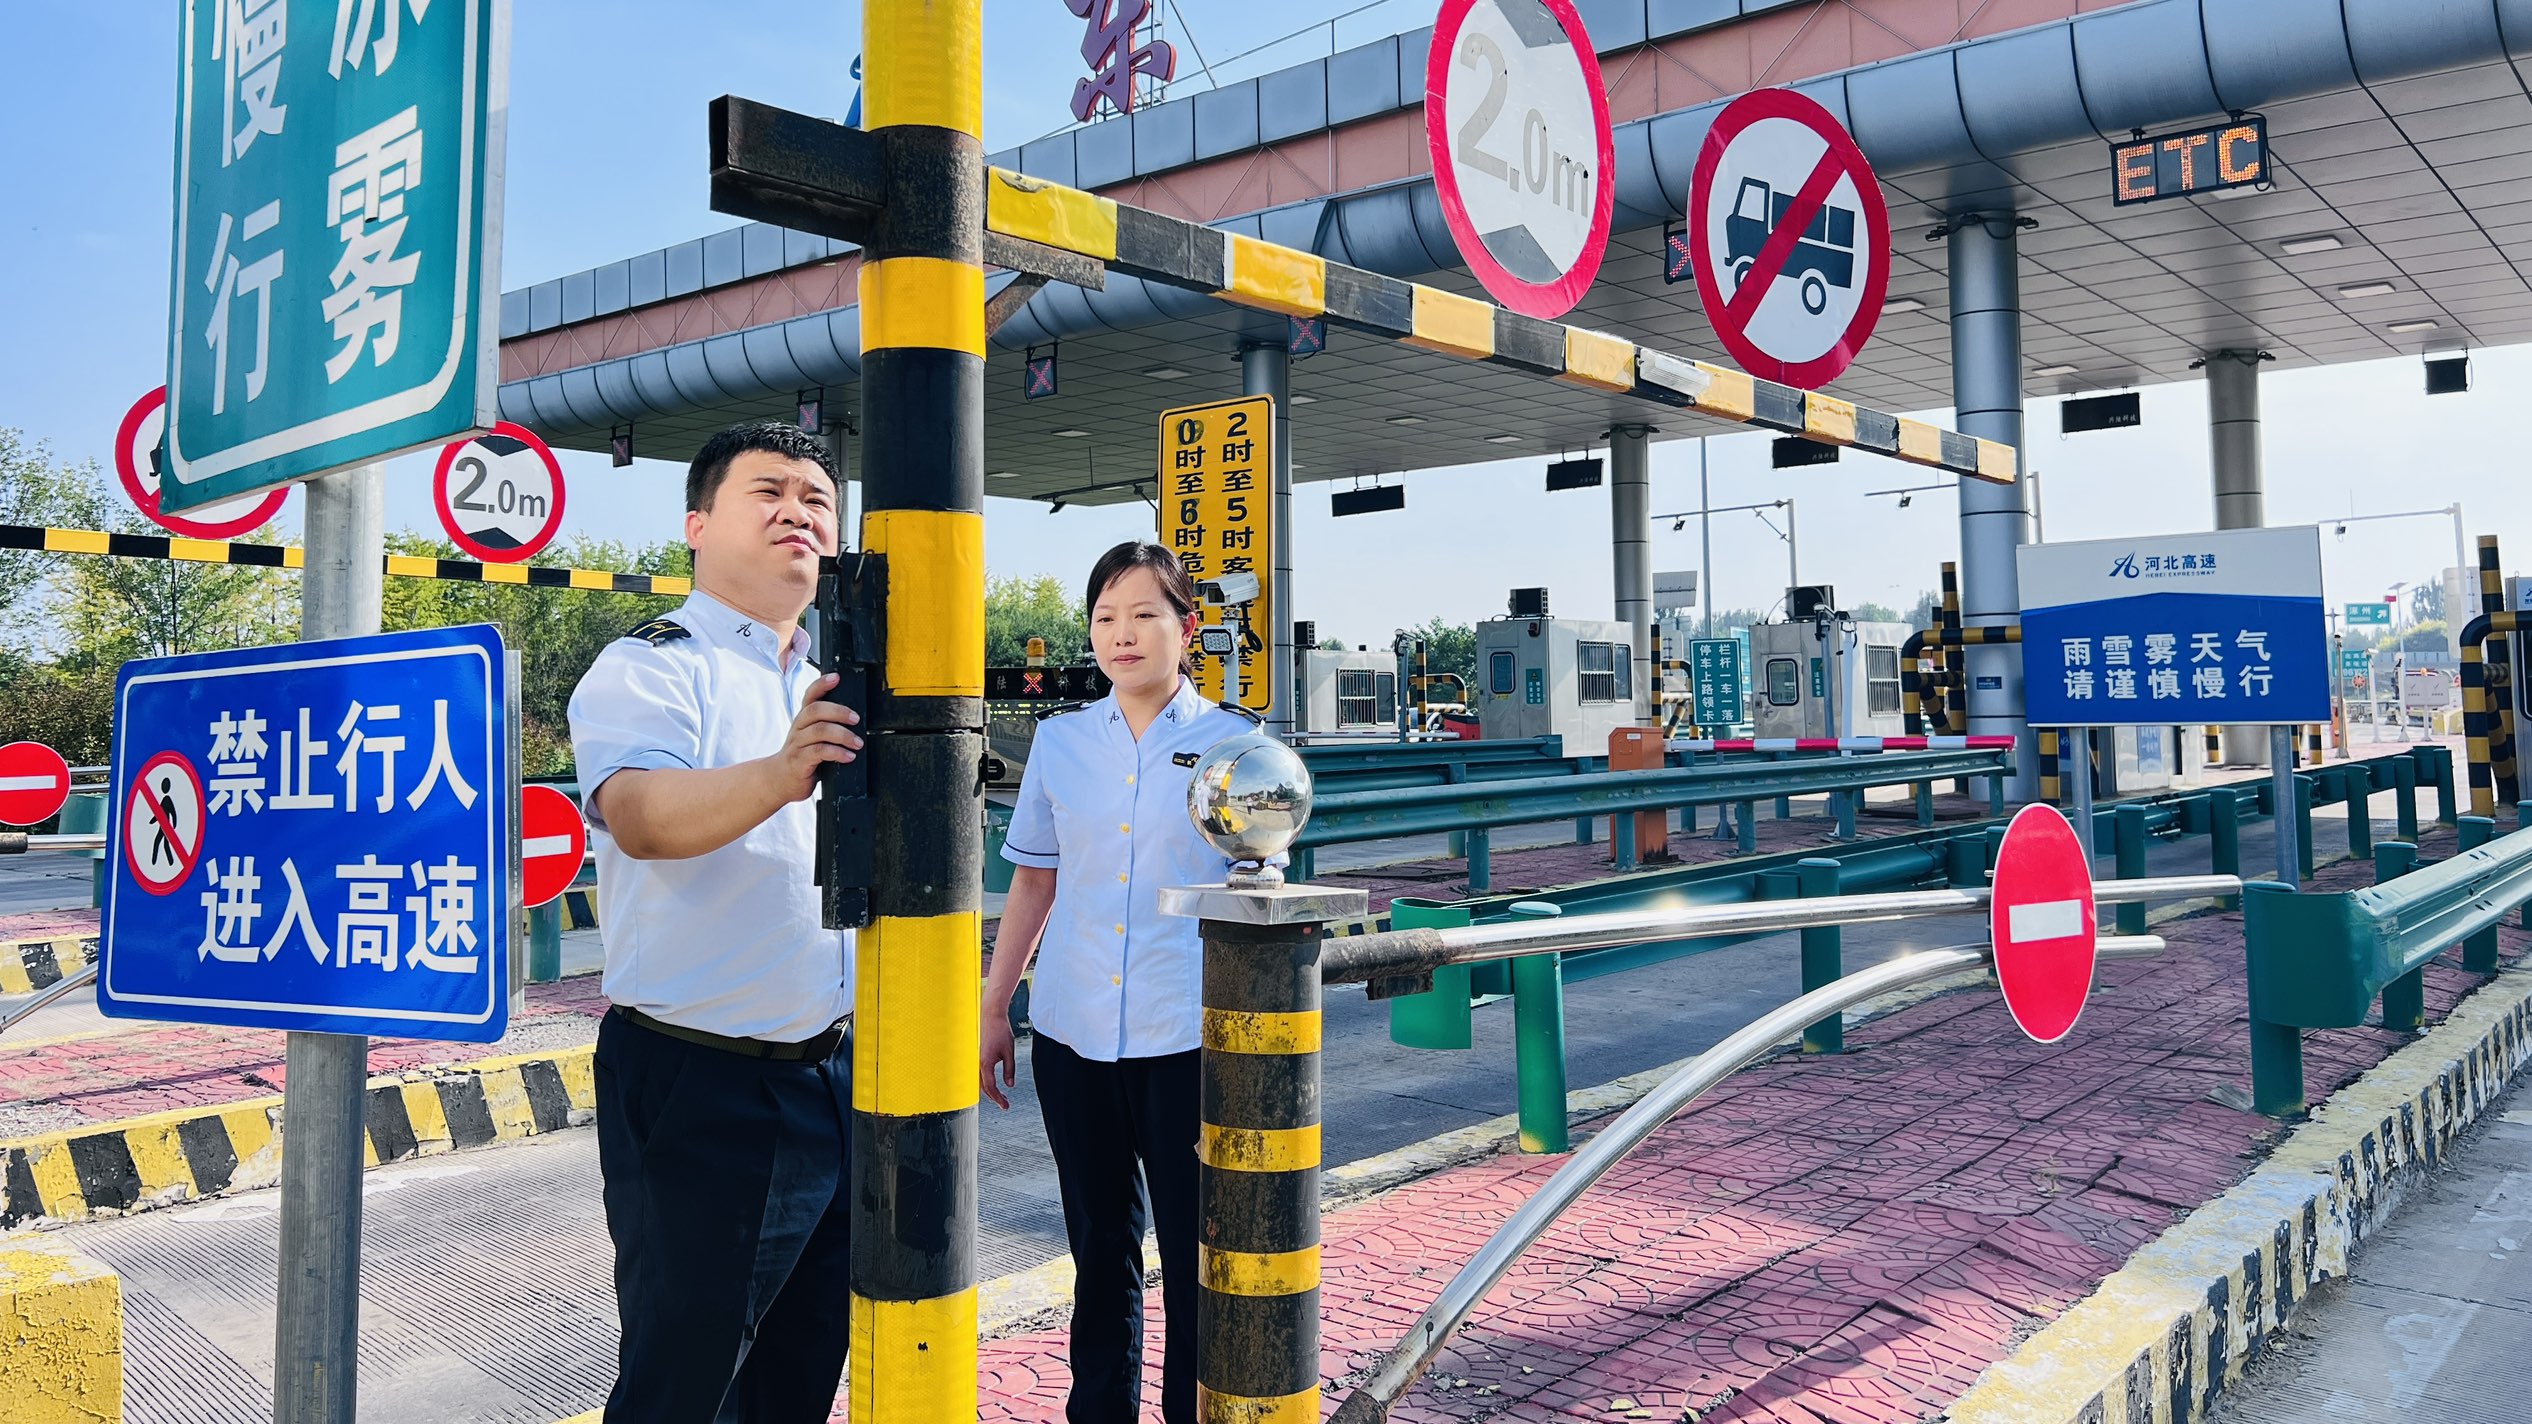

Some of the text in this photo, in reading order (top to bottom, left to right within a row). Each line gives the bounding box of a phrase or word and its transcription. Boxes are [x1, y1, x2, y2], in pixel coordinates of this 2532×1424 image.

[1456, 32, 1590, 219] 2.0m
[2116, 126, 2260, 201] ETC
[204, 0, 289, 416] 慢行
[454, 456, 547, 519] 2.0m
[1174, 418, 1206, 693] 0时至6时危
[2145, 553, 2217, 571] 河北高速
[2168, 570, 2216, 578] EXPRESSWAY
[1699, 644, 1714, 722] 停车上路领卡
[1718, 643, 1734, 721] 栏杆一车一落
[2061, 629, 2272, 667] 雨雪雾天气
[2064, 664, 2274, 700] 请谨慎慢行
[206, 697, 479, 818] 禁止行人
[197, 853, 480, 974] 进入高速
